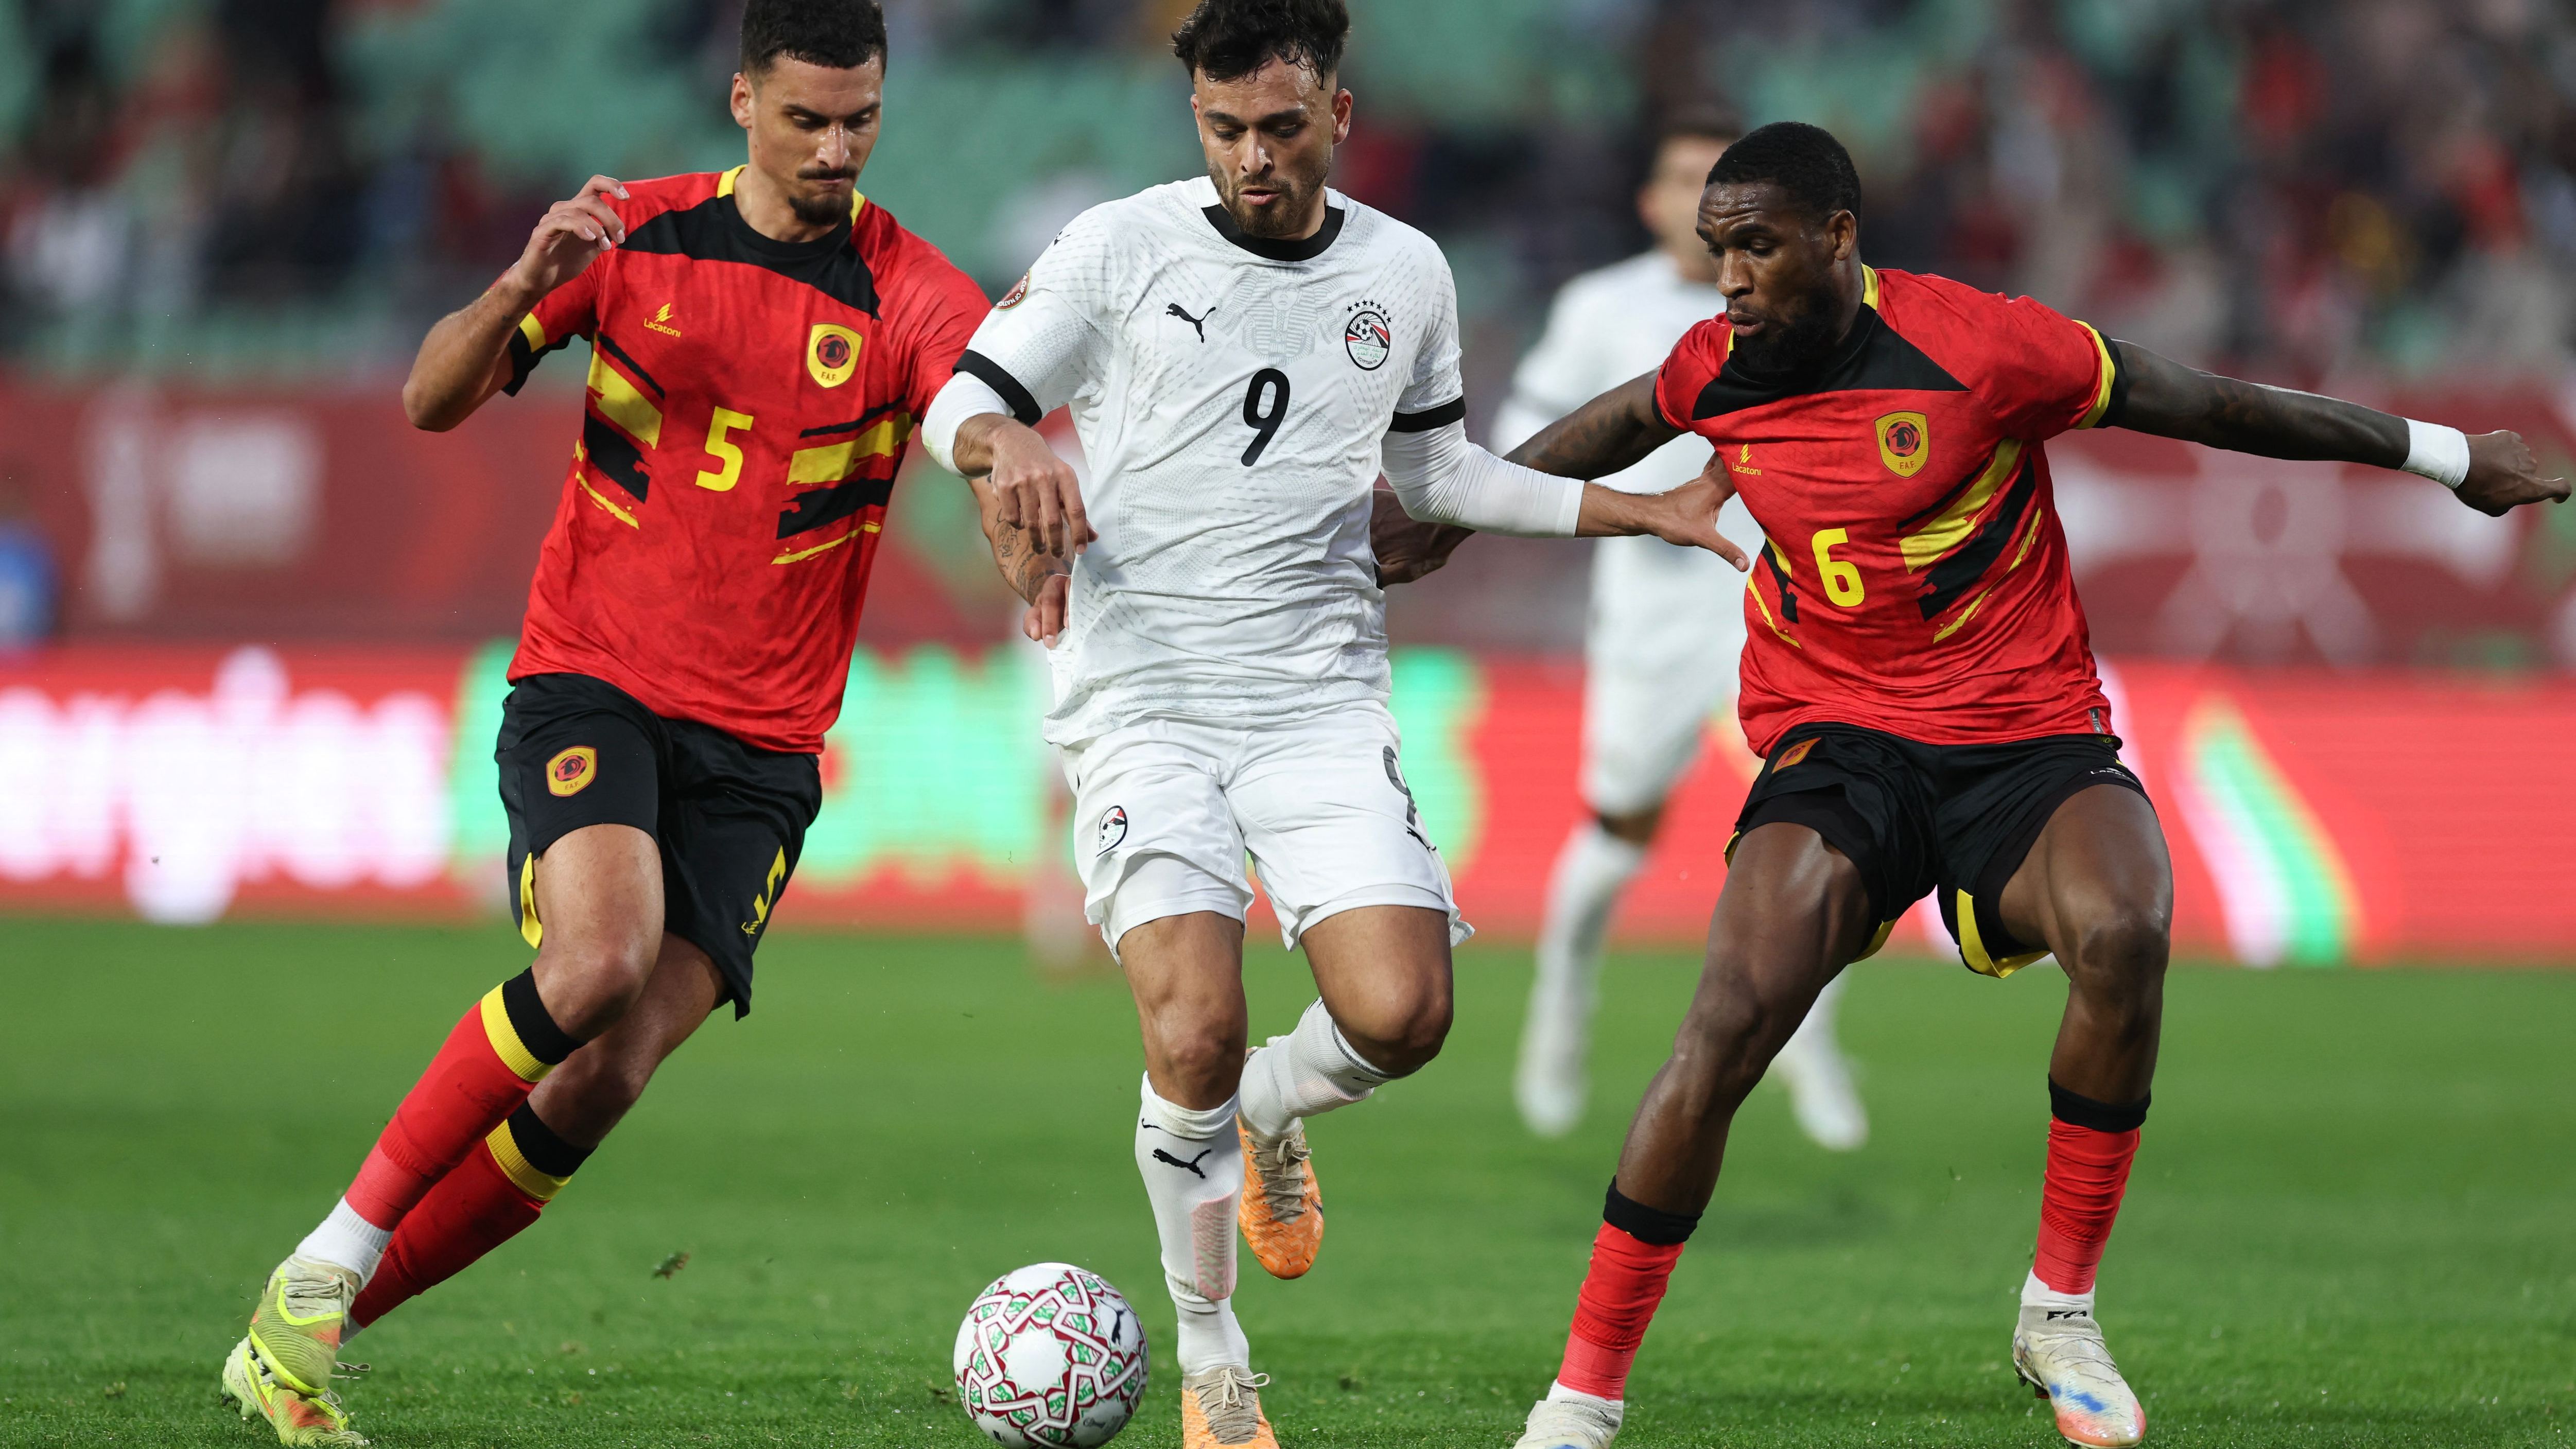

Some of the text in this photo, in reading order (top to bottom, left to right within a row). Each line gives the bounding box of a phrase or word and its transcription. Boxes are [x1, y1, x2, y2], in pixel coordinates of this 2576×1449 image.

[643, 318, 681, 338] Lacatoni
[1015, 293, 1022, 301] OF
[1357, 356, 1372, 364] EGYPTIAN
[695, 406, 754, 492] 5
[1241, 368, 1290, 467] 9
[1732, 462, 1761, 476] Lacatoni
[1812, 528, 1865, 607] 6
[1383, 745, 1417, 827] 9
[754, 845, 786, 923] 5
